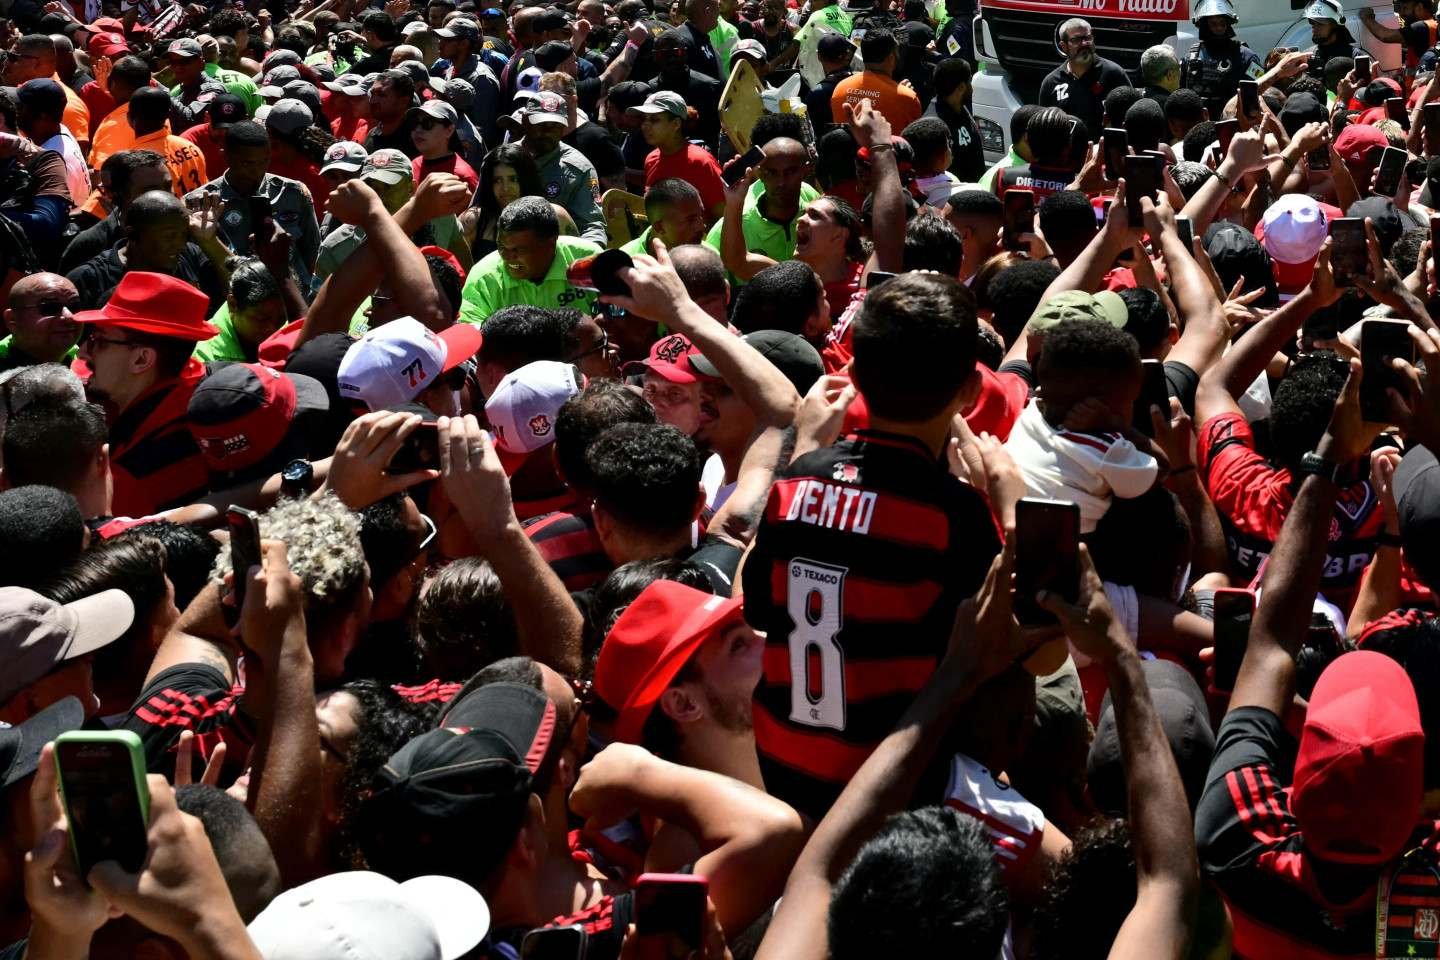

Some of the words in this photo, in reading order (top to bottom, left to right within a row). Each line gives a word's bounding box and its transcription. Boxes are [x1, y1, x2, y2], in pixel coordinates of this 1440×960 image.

[846, 87, 881, 99] CLEANING
[1054, 82, 1070, 101] 12
[957, 126, 972, 147] 49
[401, 357, 425, 390] 77
[785, 479, 879, 535] BENTO
[803, 568, 838, 585] TEXACO
[788, 556, 848, 732] 8
